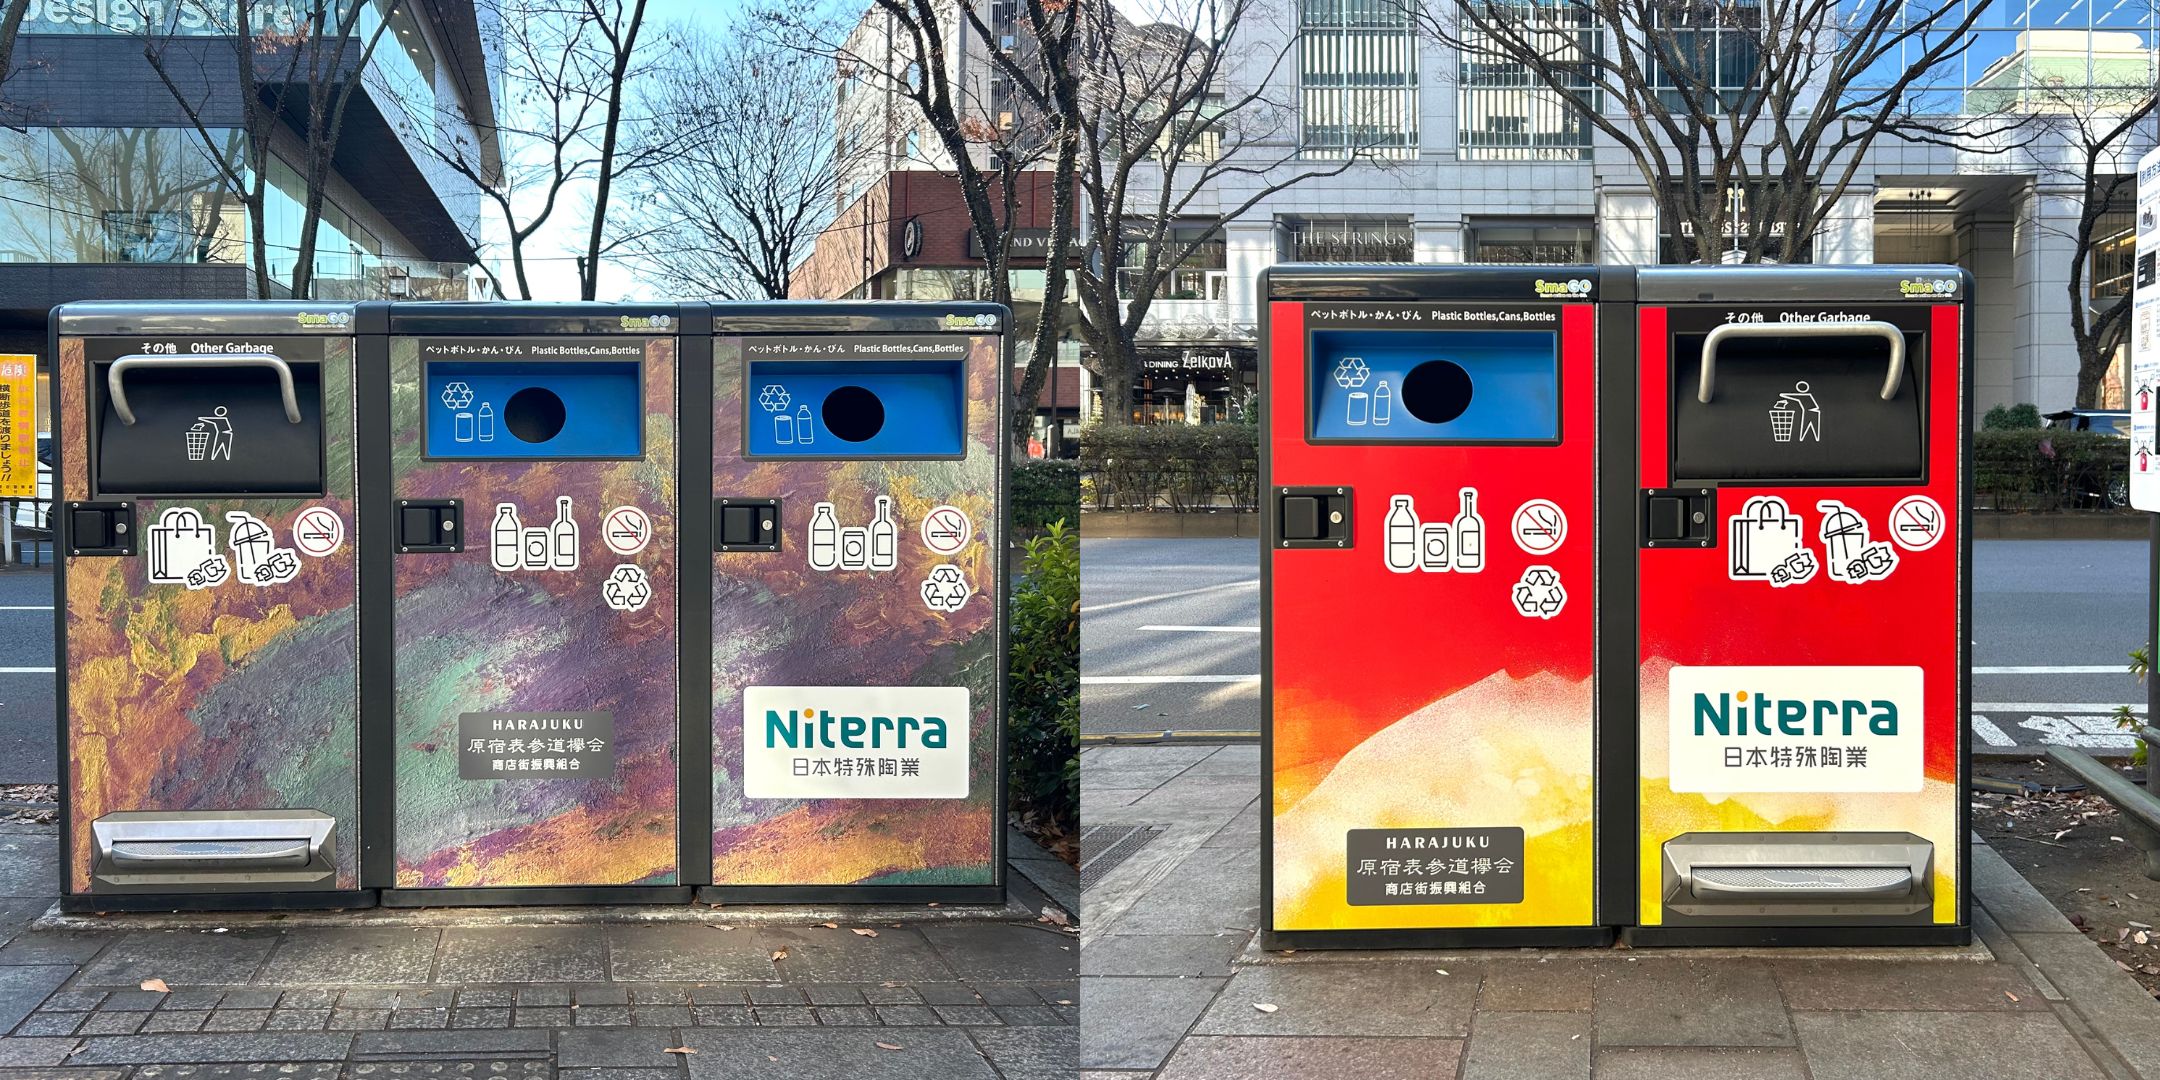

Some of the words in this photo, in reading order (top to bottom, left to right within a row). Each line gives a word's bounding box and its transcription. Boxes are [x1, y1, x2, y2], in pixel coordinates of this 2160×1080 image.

[1290, 231, 1325, 245] THE
[1332, 231, 1407, 246] STRINGS
[1535, 279, 1592, 293] SmaGO
[1900, 279, 1957, 293] SmaGO
[298, 311, 350, 323] SmaGO
[620, 315, 671, 327] SmaGO
[946, 314, 997, 326] SmaGO
[1310, 309, 1422, 321] ペットボトル・かん・びん
[1431, 310, 1463, 321] Plastic
[1464, 311, 1556, 322] Bottles,Cans,Bottles
[1725, 312, 1764, 323] その他
[1779, 311, 1816, 322] Other
[1818, 311, 1871, 323] Garbage
[141, 342, 177, 354] その他
[190, 342, 224, 353] Other
[225, 342, 274, 354] Garbage
[426, 345, 523, 355] ペットボトル・かん・びん
[531, 345, 558, 355] Plastic
[559, 345, 641, 356] Bottles,Cans,Bottles
[748, 343, 846, 354] ペットボトル・かん・びん
[853, 344, 881, 353] Plastic
[881, 344, 964, 354] Bottles,Cans,Bottles
[1148, 360, 1179, 369] DINING
[1694, 690, 1899, 736] Niterra
[492, 718, 584, 731] HARAJUKU
[766, 708, 947, 749] Niterra
[1724, 746, 1868, 768] 日本特殊陶業
[492, 758, 581, 771] 商店街振興組合
[793, 757, 920, 777] 日本特殊陶業
[1386, 836, 1490, 849] HARAJUKU
[1385, 880, 1487, 896] 商店街振興組合
